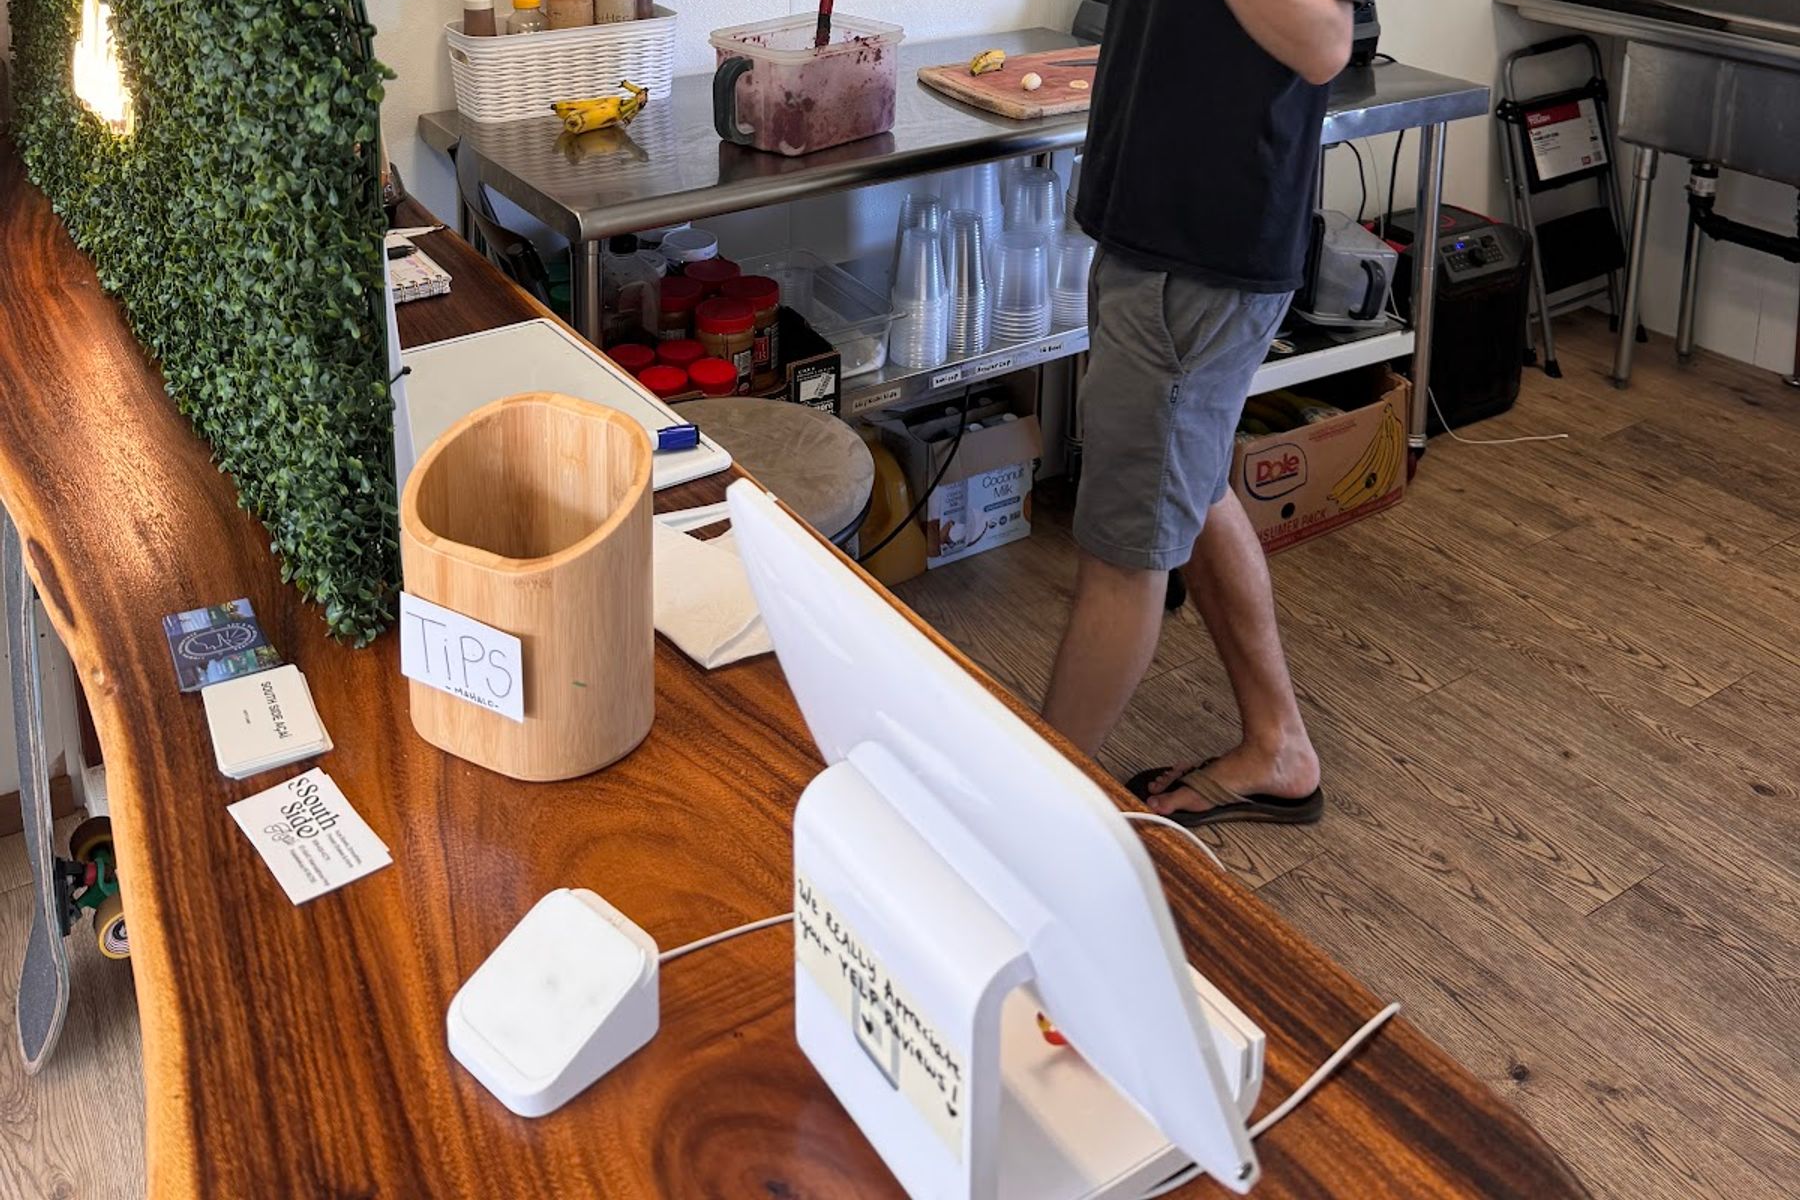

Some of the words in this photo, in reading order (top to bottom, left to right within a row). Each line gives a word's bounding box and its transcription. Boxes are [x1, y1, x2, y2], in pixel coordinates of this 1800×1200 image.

[982, 468, 1024, 488] Coconut
[1256, 453, 1300, 482] Dole
[993, 484, 1013, 498] Milk
[1302, 508, 1327, 525] PACK
[261, 681, 276, 705] SOUTH
[269, 704, 283, 721] SIDE
[280, 801, 319, 838] Side
[293, 781, 339, 831] South
[798, 878, 818, 915] We
[799, 911, 831, 953] your
[839, 955, 878, 1005] YELP
